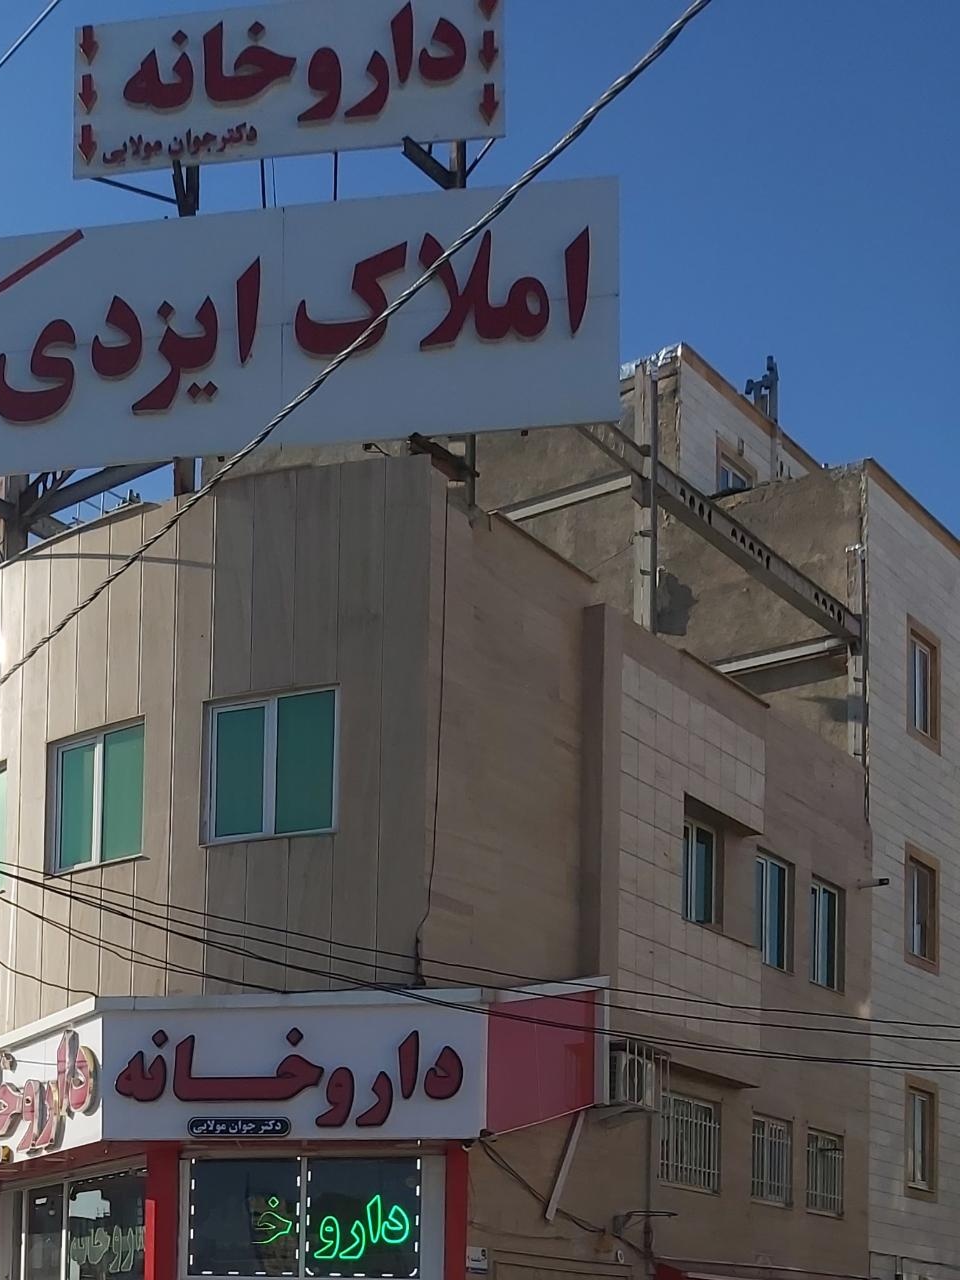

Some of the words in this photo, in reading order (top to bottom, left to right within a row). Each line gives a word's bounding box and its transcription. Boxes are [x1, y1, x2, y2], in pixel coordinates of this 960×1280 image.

[123, 1, 467, 125] داروخانه
[216, 122, 257, 152] دکتر
[293, 225, 590, 359] املاک
[115, 1027, 464, 1127] داروخانه
[228, 1119, 256, 1134] جوان
[258, 1119, 282, 1134] دکتر
